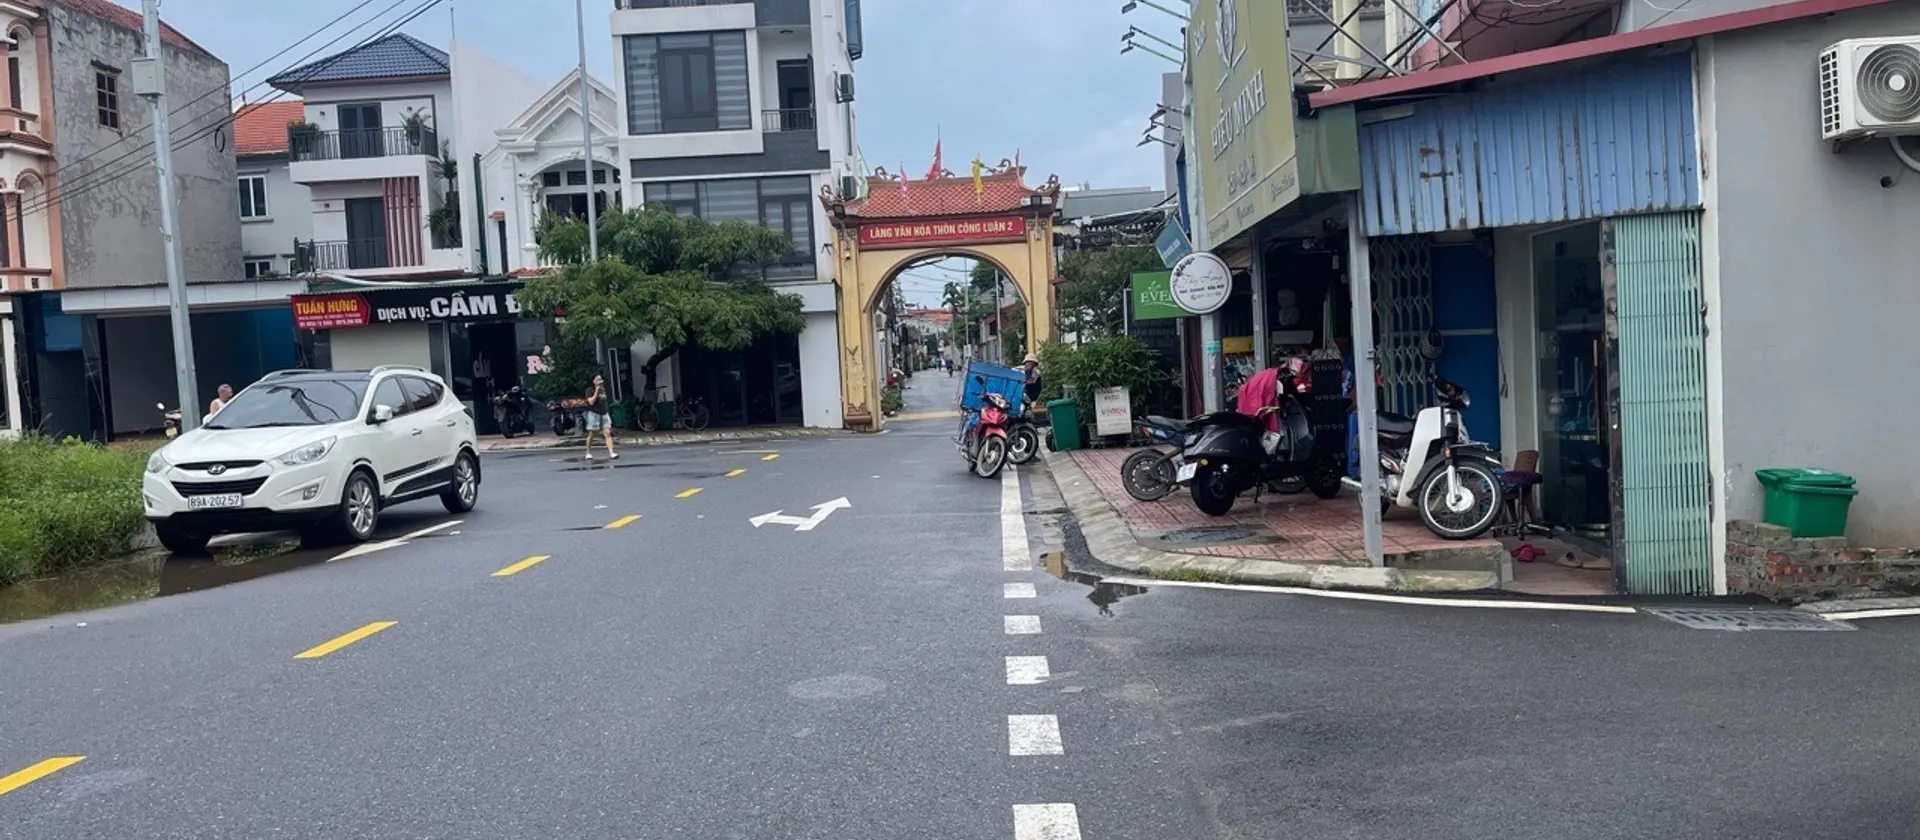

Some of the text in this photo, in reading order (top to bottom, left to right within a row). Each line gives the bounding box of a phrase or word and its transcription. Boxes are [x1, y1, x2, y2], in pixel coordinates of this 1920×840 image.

[870, 221, 1014, 239] LÀNG VĂN HÓA THÔN CÔNG LUẬN 2
[296, 298, 358, 315] TUẤN HƯNG
[377, 307, 407, 323] DỊCH
[408, 305, 430, 322] VỤ:
[430, 290, 498, 318] CẦM
